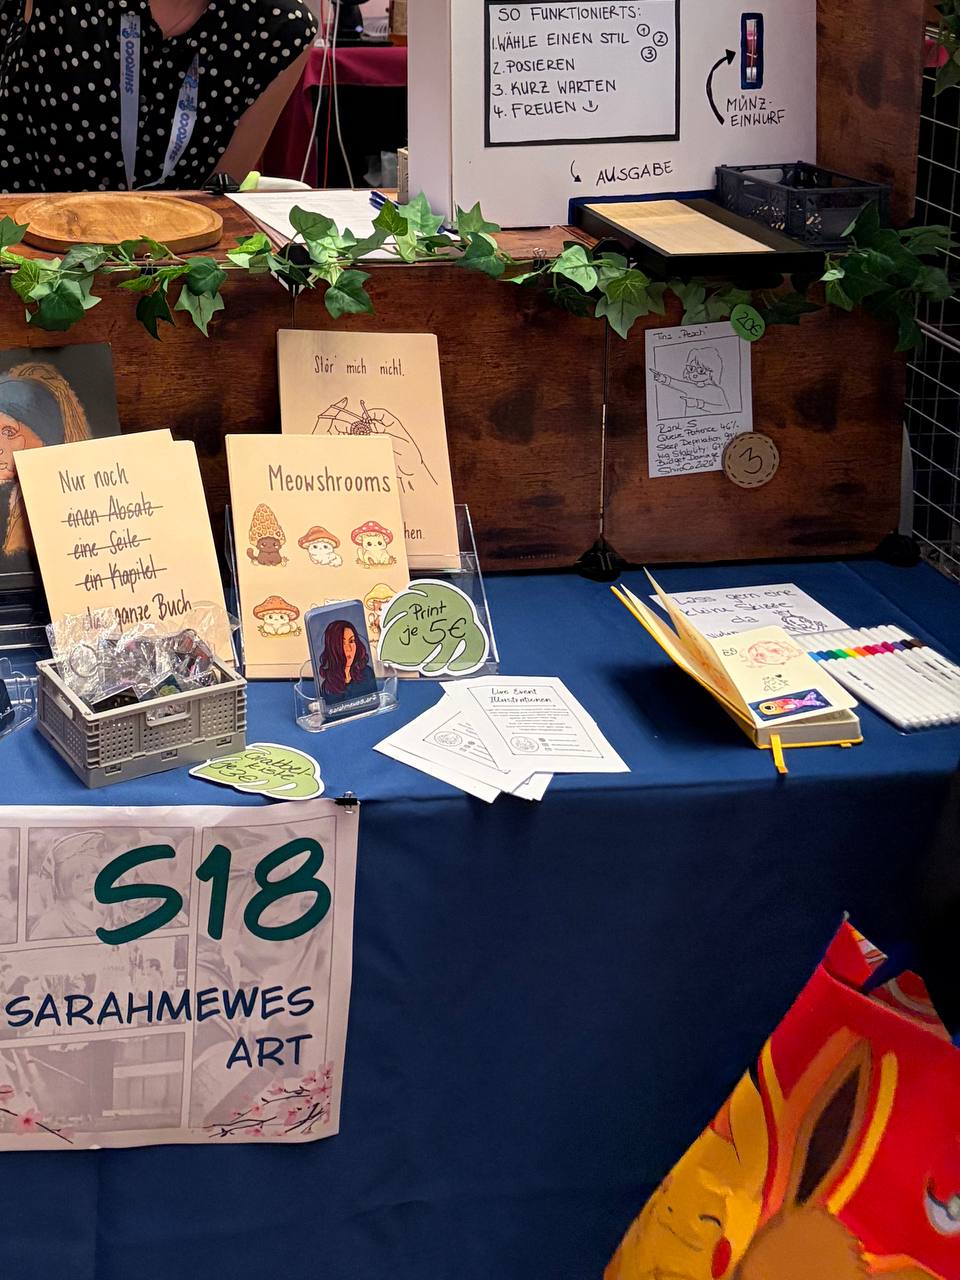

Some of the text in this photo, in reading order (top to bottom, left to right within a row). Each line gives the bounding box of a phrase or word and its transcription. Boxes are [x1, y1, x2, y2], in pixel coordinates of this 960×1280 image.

[498, 5, 641, 21] SO FUNKTIONIERTS:
[547, 32, 593, 46] EINEN
[600, 32, 630, 44] STIL
[124, 40, 136, 95] SHIROCO
[492, 79, 617, 97] 3. KURZ WARTEN
[493, 100, 577, 118] 4. FREUEN
[726, 95, 772, 112] MÜNZ-
[730, 108, 785, 128] EINWURF
[169, 112, 190, 161] SHIROCO
[595, 160, 674, 187] AUSGABE
[735, 311, 763, 337] 20€
[346, 357, 367, 375] mich
[379, 358, 405, 377] nicht.
[738, 447, 763, 475] 3
[58, 462, 129, 494] Nur noch
[268, 464, 392, 494] Meowshrooms
[67, 491, 154, 528] einen Absatz
[74, 537, 99, 560] eine
[84, 569, 103, 592] ein
[114, 603, 152, 633] ganze
[408, 600, 447, 621] Print
[399, 617, 467, 646] je 5€
[93, 836, 332, 946] S18
[5, 985, 314, 1028] SARAHMEWES
[226, 1032, 313, 1070] ART
